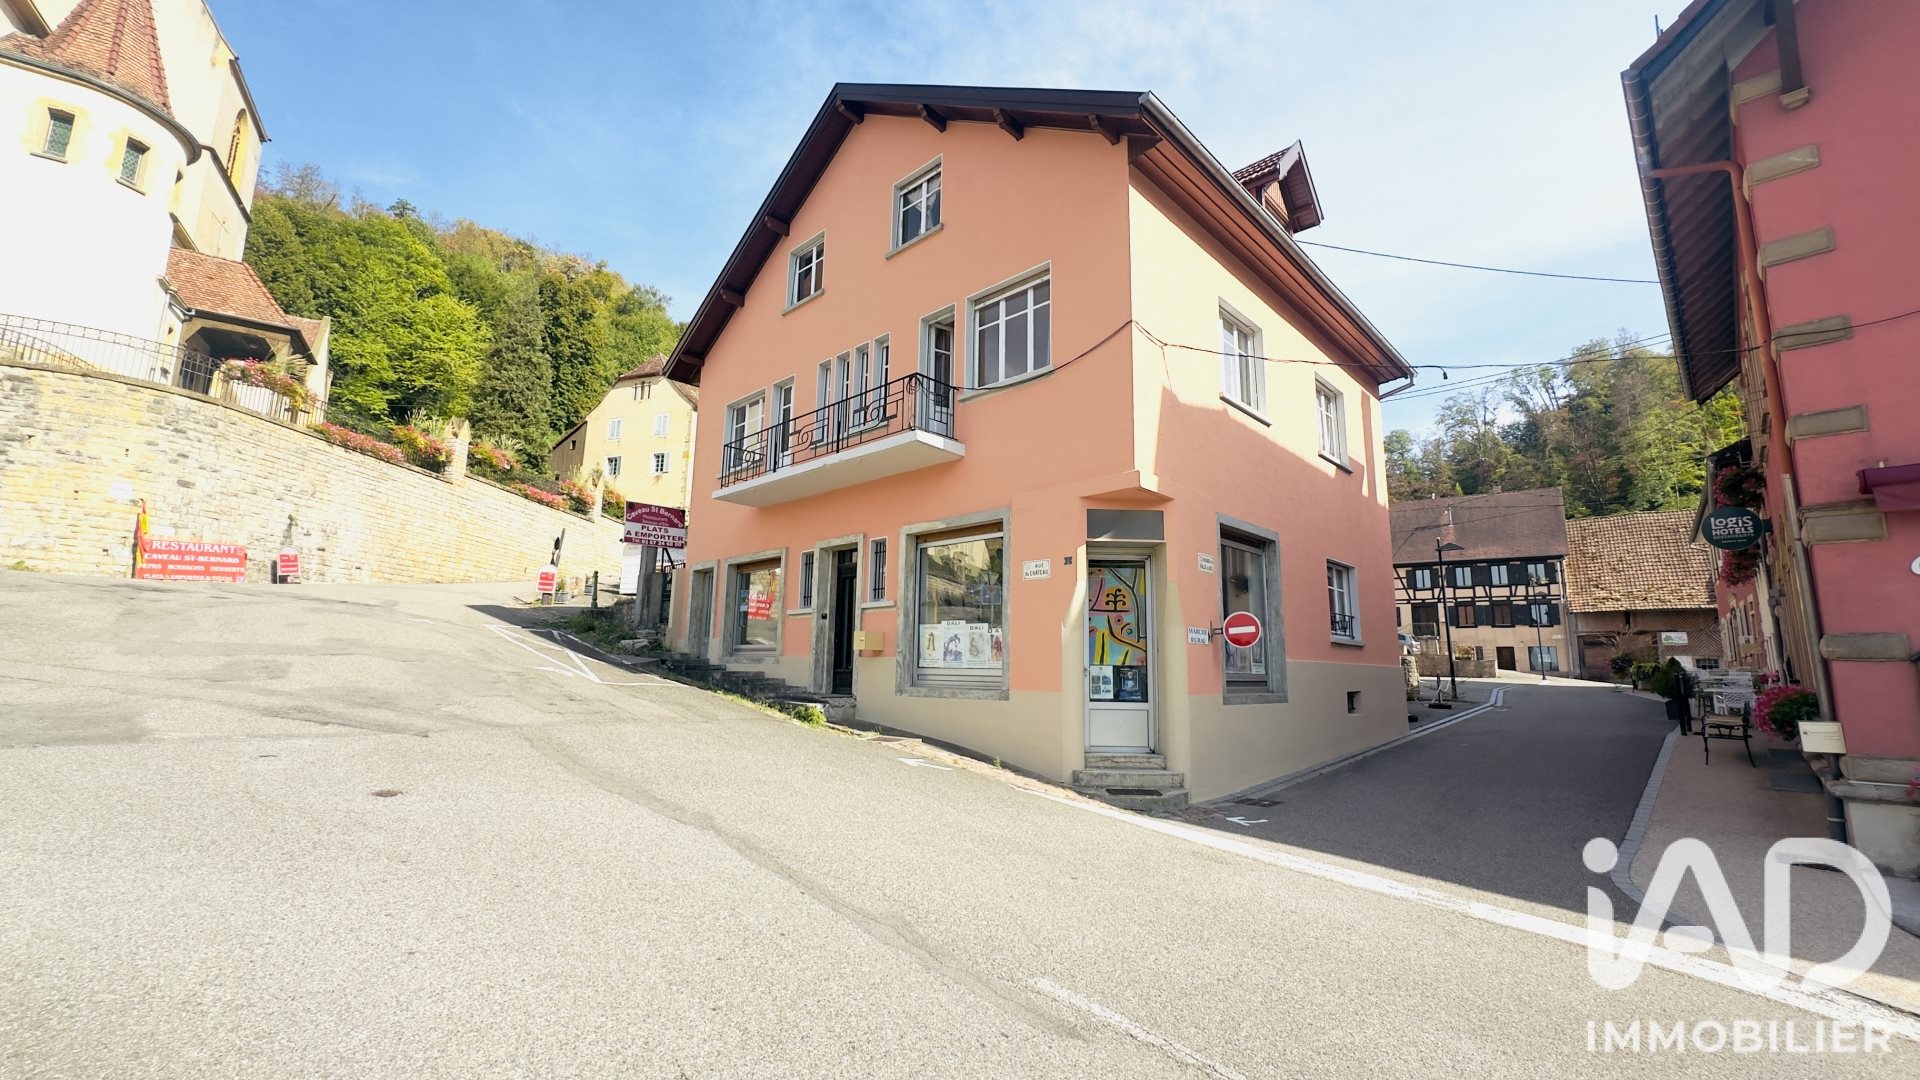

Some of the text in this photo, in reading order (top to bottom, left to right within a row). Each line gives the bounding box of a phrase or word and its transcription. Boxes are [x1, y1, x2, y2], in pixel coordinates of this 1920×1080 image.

[626, 507, 650, 520] Caveau
[660, 508, 684, 528] Bernard
[641, 525, 669, 534] PLATS
[1712, 526, 1754, 536] HOTELS
[634, 531, 684, 542] EMPORTER
[152, 541, 237, 554] RESTAURANT
[144, 552, 240, 564] CAVEAU ST-BERNARD
[167, 564, 206, 572] BOISSONS
